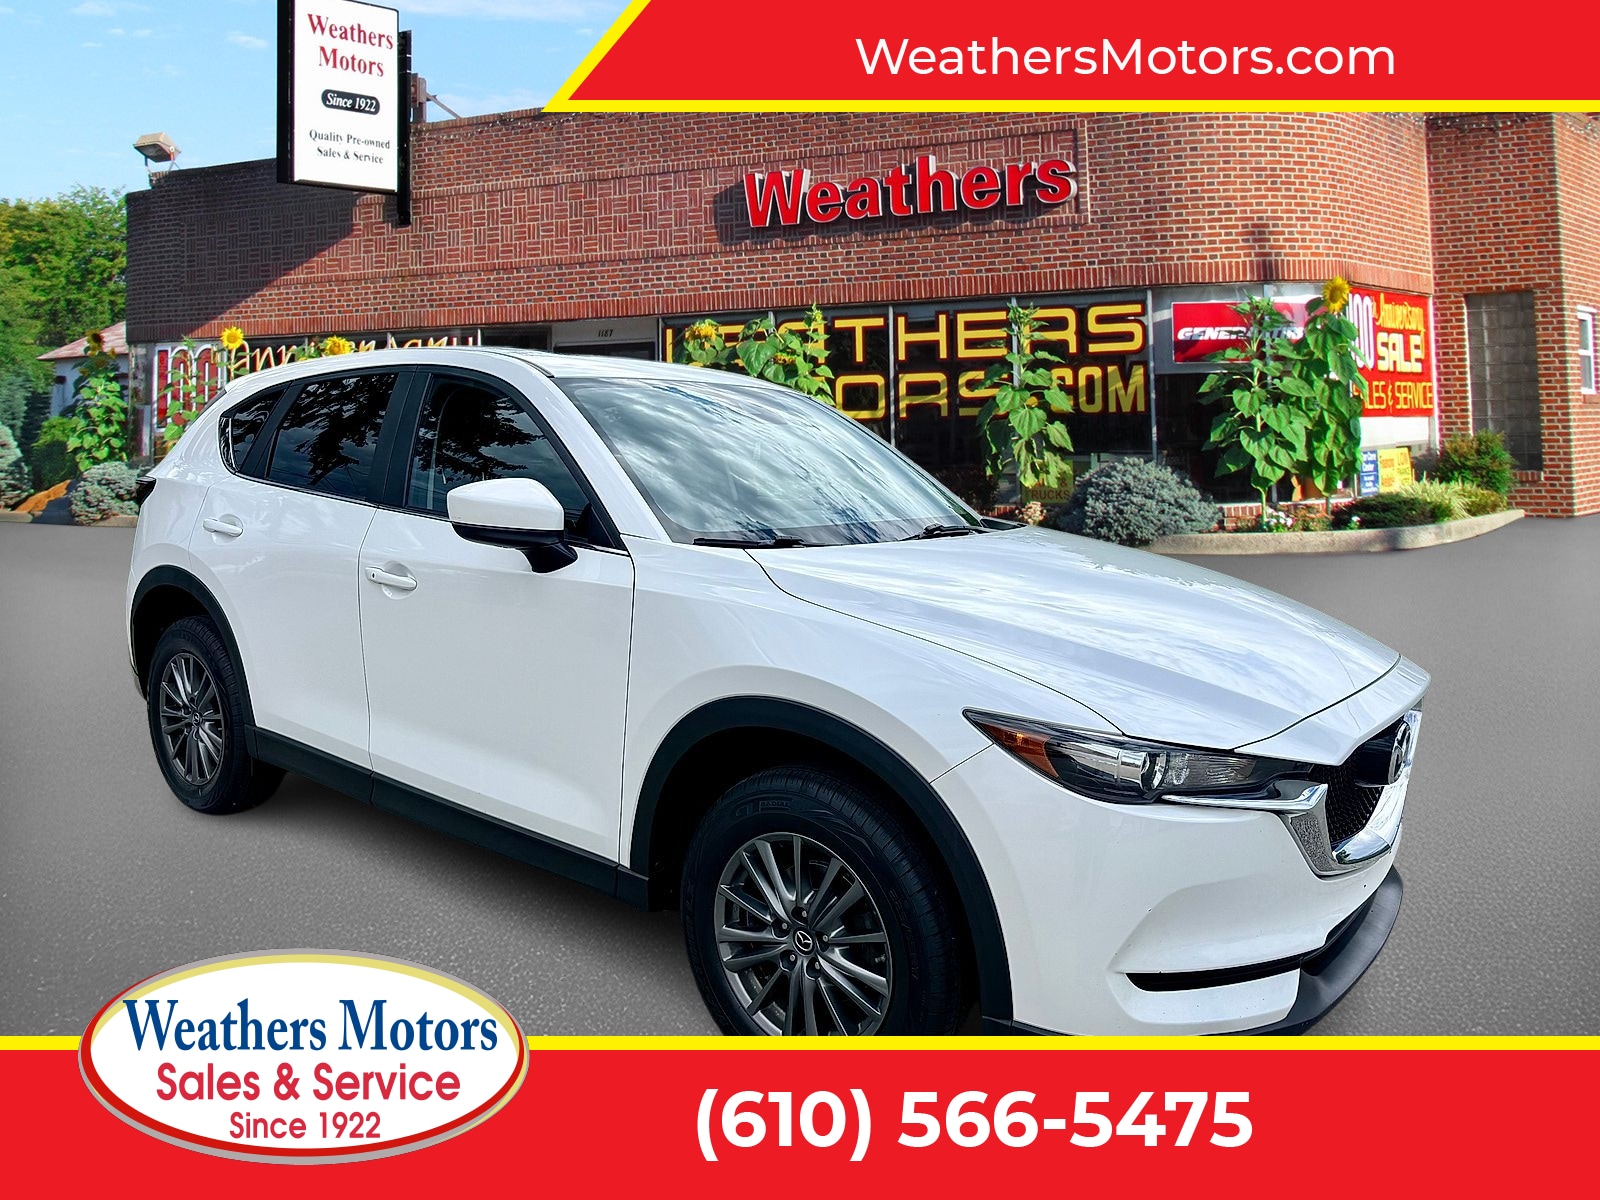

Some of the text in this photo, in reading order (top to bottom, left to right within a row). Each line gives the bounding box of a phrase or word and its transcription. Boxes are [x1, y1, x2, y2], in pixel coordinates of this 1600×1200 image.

[307, 13, 394, 50] Weathers
[318, 45, 385, 77] Motors
[326, 92, 376, 112] Since 1922
[309, 129, 390, 149] Quality Pre-owned
[317, 146, 384, 164] Sales & Service
[743, 154, 1077, 228] Weathers
[598, 328, 614, 338] 1187
[664, 303, 1146, 366] EATHERS
[1377, 332, 1422, 373] SALE
[1353, 381, 1387, 409] LES
[1395, 381, 1433, 409] SERVICE
